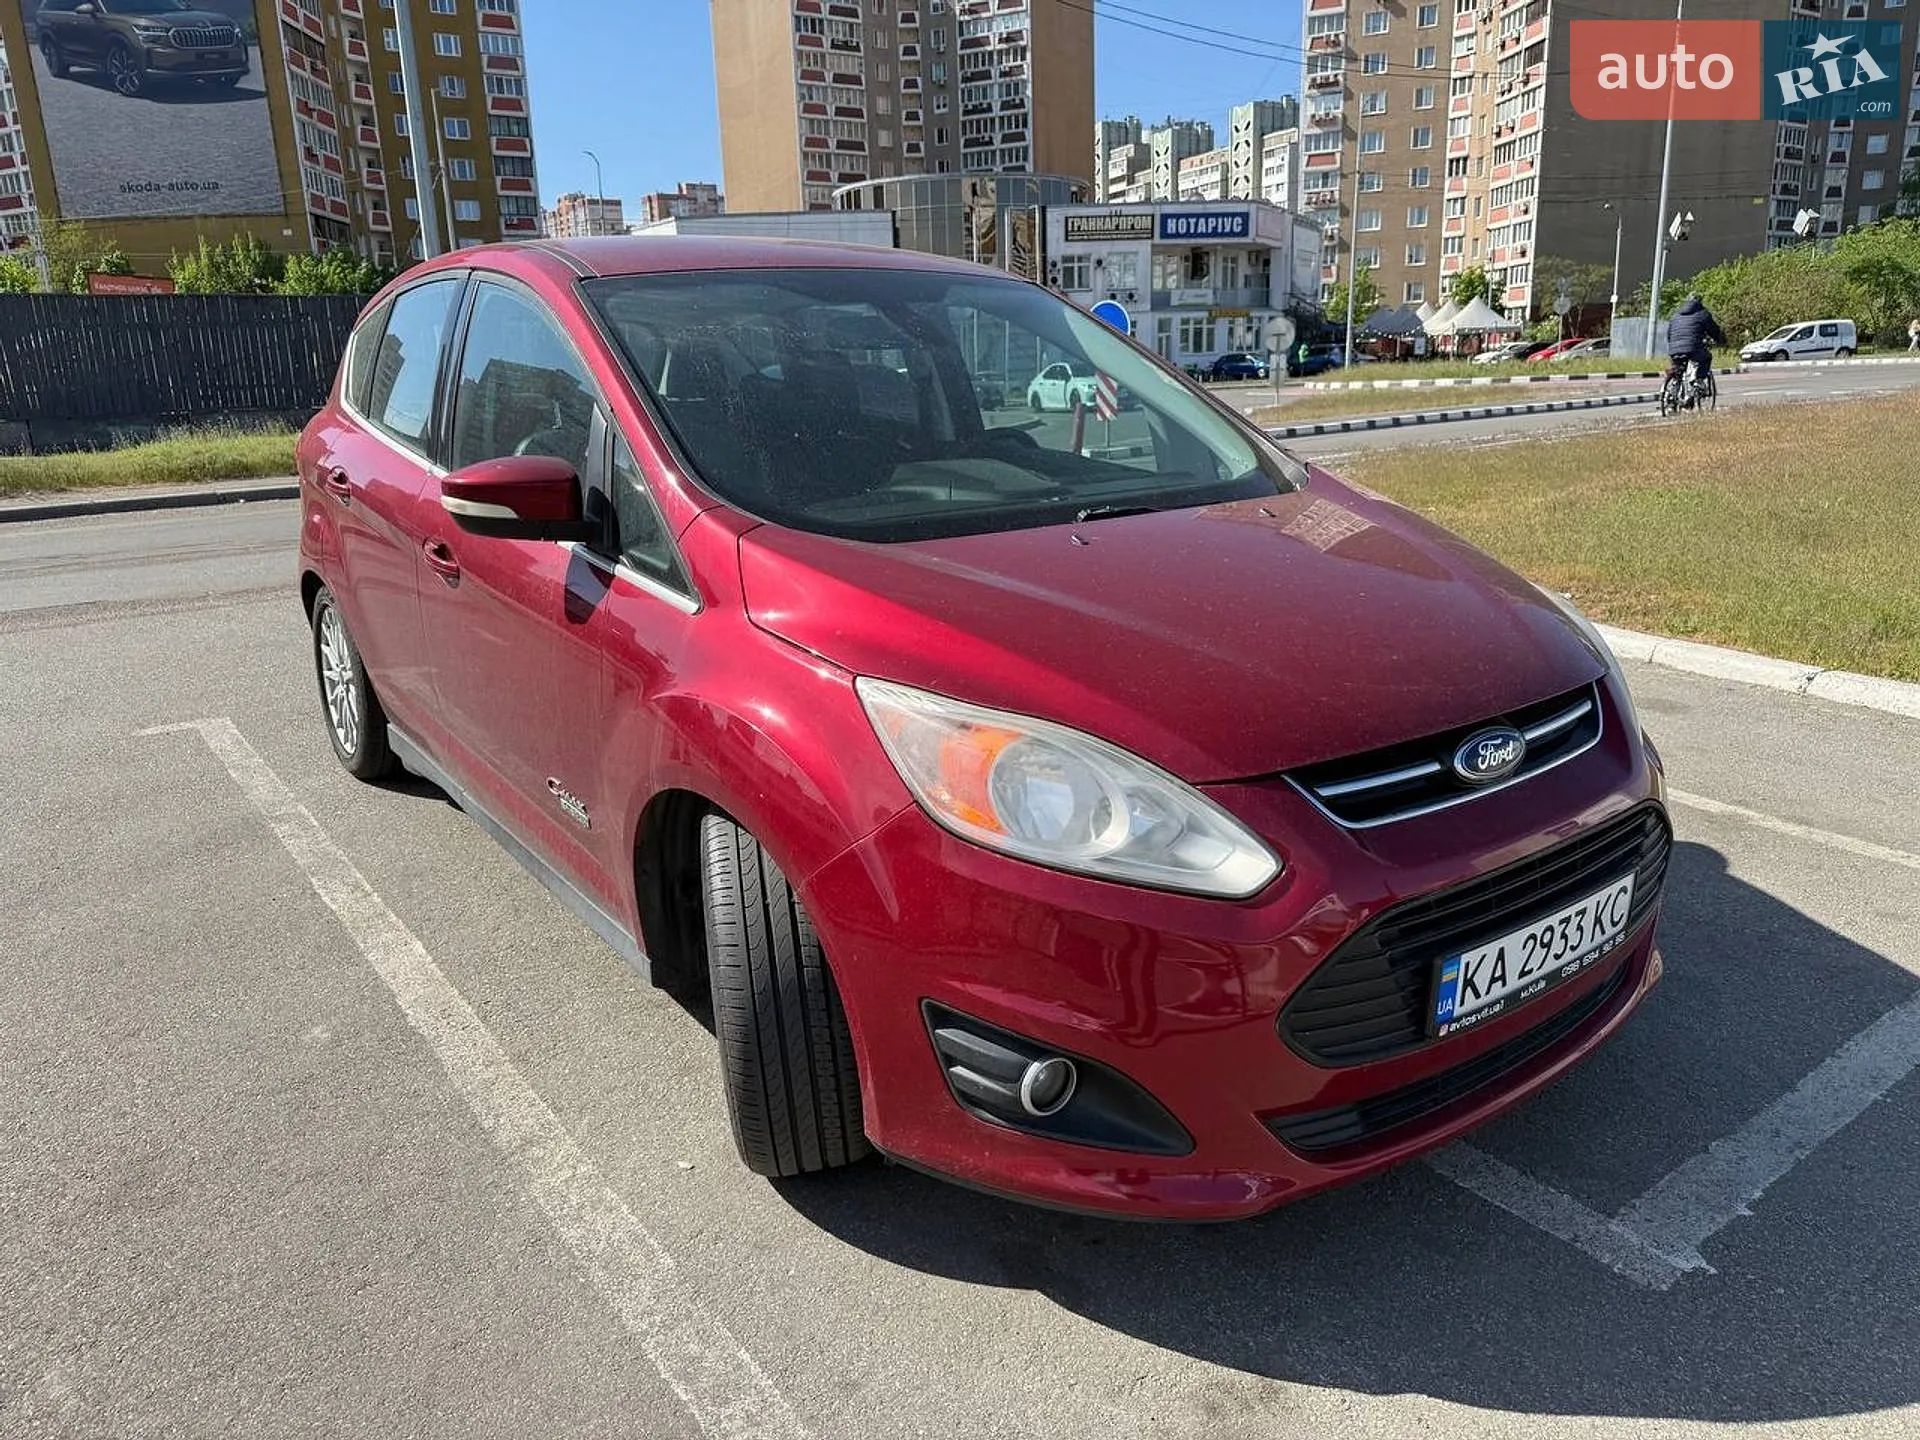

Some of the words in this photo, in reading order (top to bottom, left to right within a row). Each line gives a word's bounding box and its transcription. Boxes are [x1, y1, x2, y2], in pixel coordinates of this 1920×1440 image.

[120, 181, 220, 194] skoda-auto.ua
[1167, 216, 1243, 234] НОТАРІУС
[1477, 737, 1515, 770] Ford
[1458, 946, 1508, 1008] KA
[1517, 906, 1588, 980] 2933
[1590, 885, 1629, 943] KC
[1437, 998, 1453, 1016] UA
